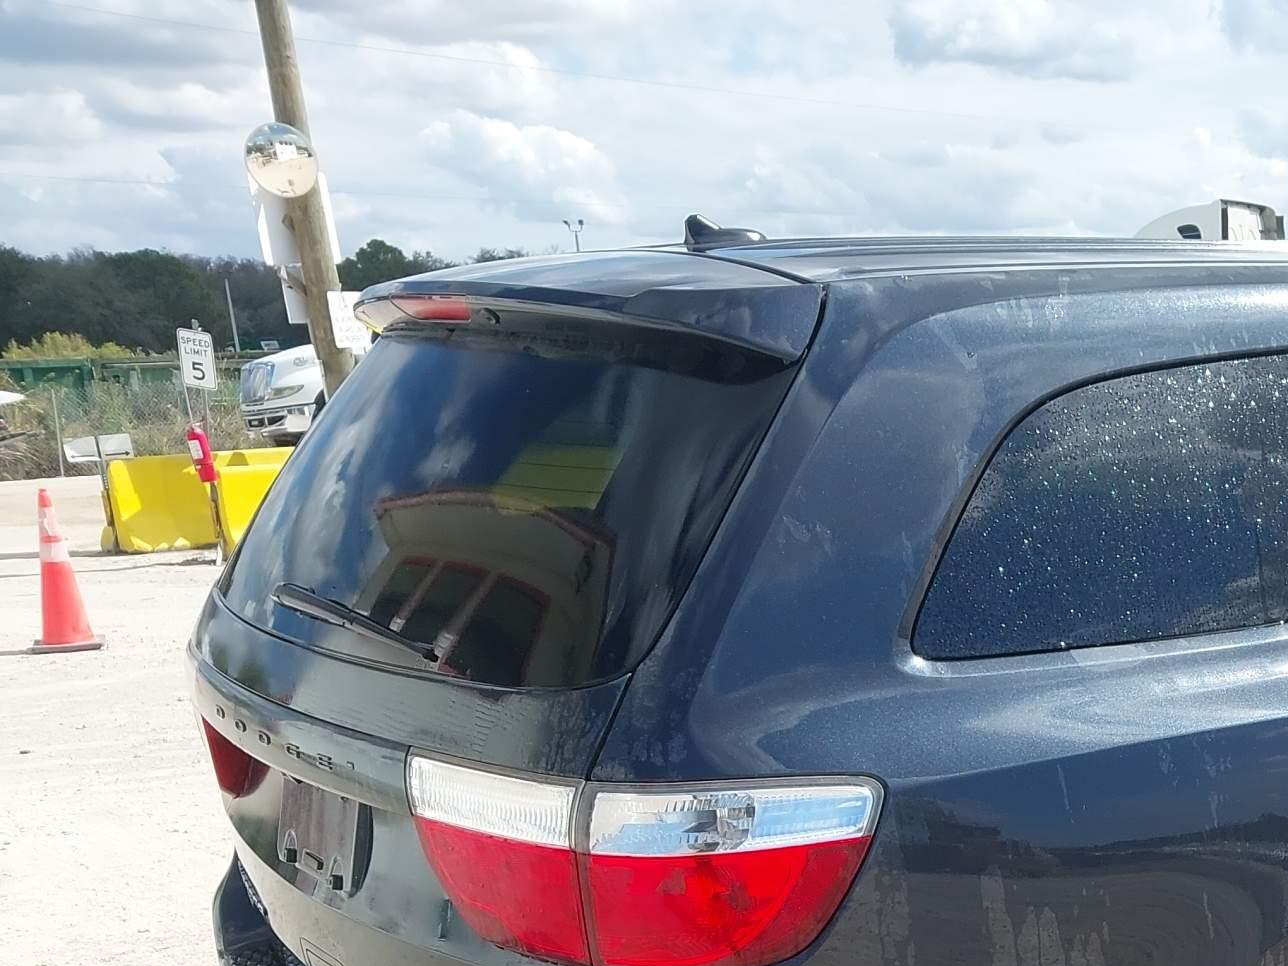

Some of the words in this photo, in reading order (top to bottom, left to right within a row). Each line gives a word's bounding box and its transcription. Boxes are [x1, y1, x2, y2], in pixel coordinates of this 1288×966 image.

[181, 336, 209, 348] SPEED
[184, 346, 208, 357] LIMIT
[191, 361, 205, 380] 5
